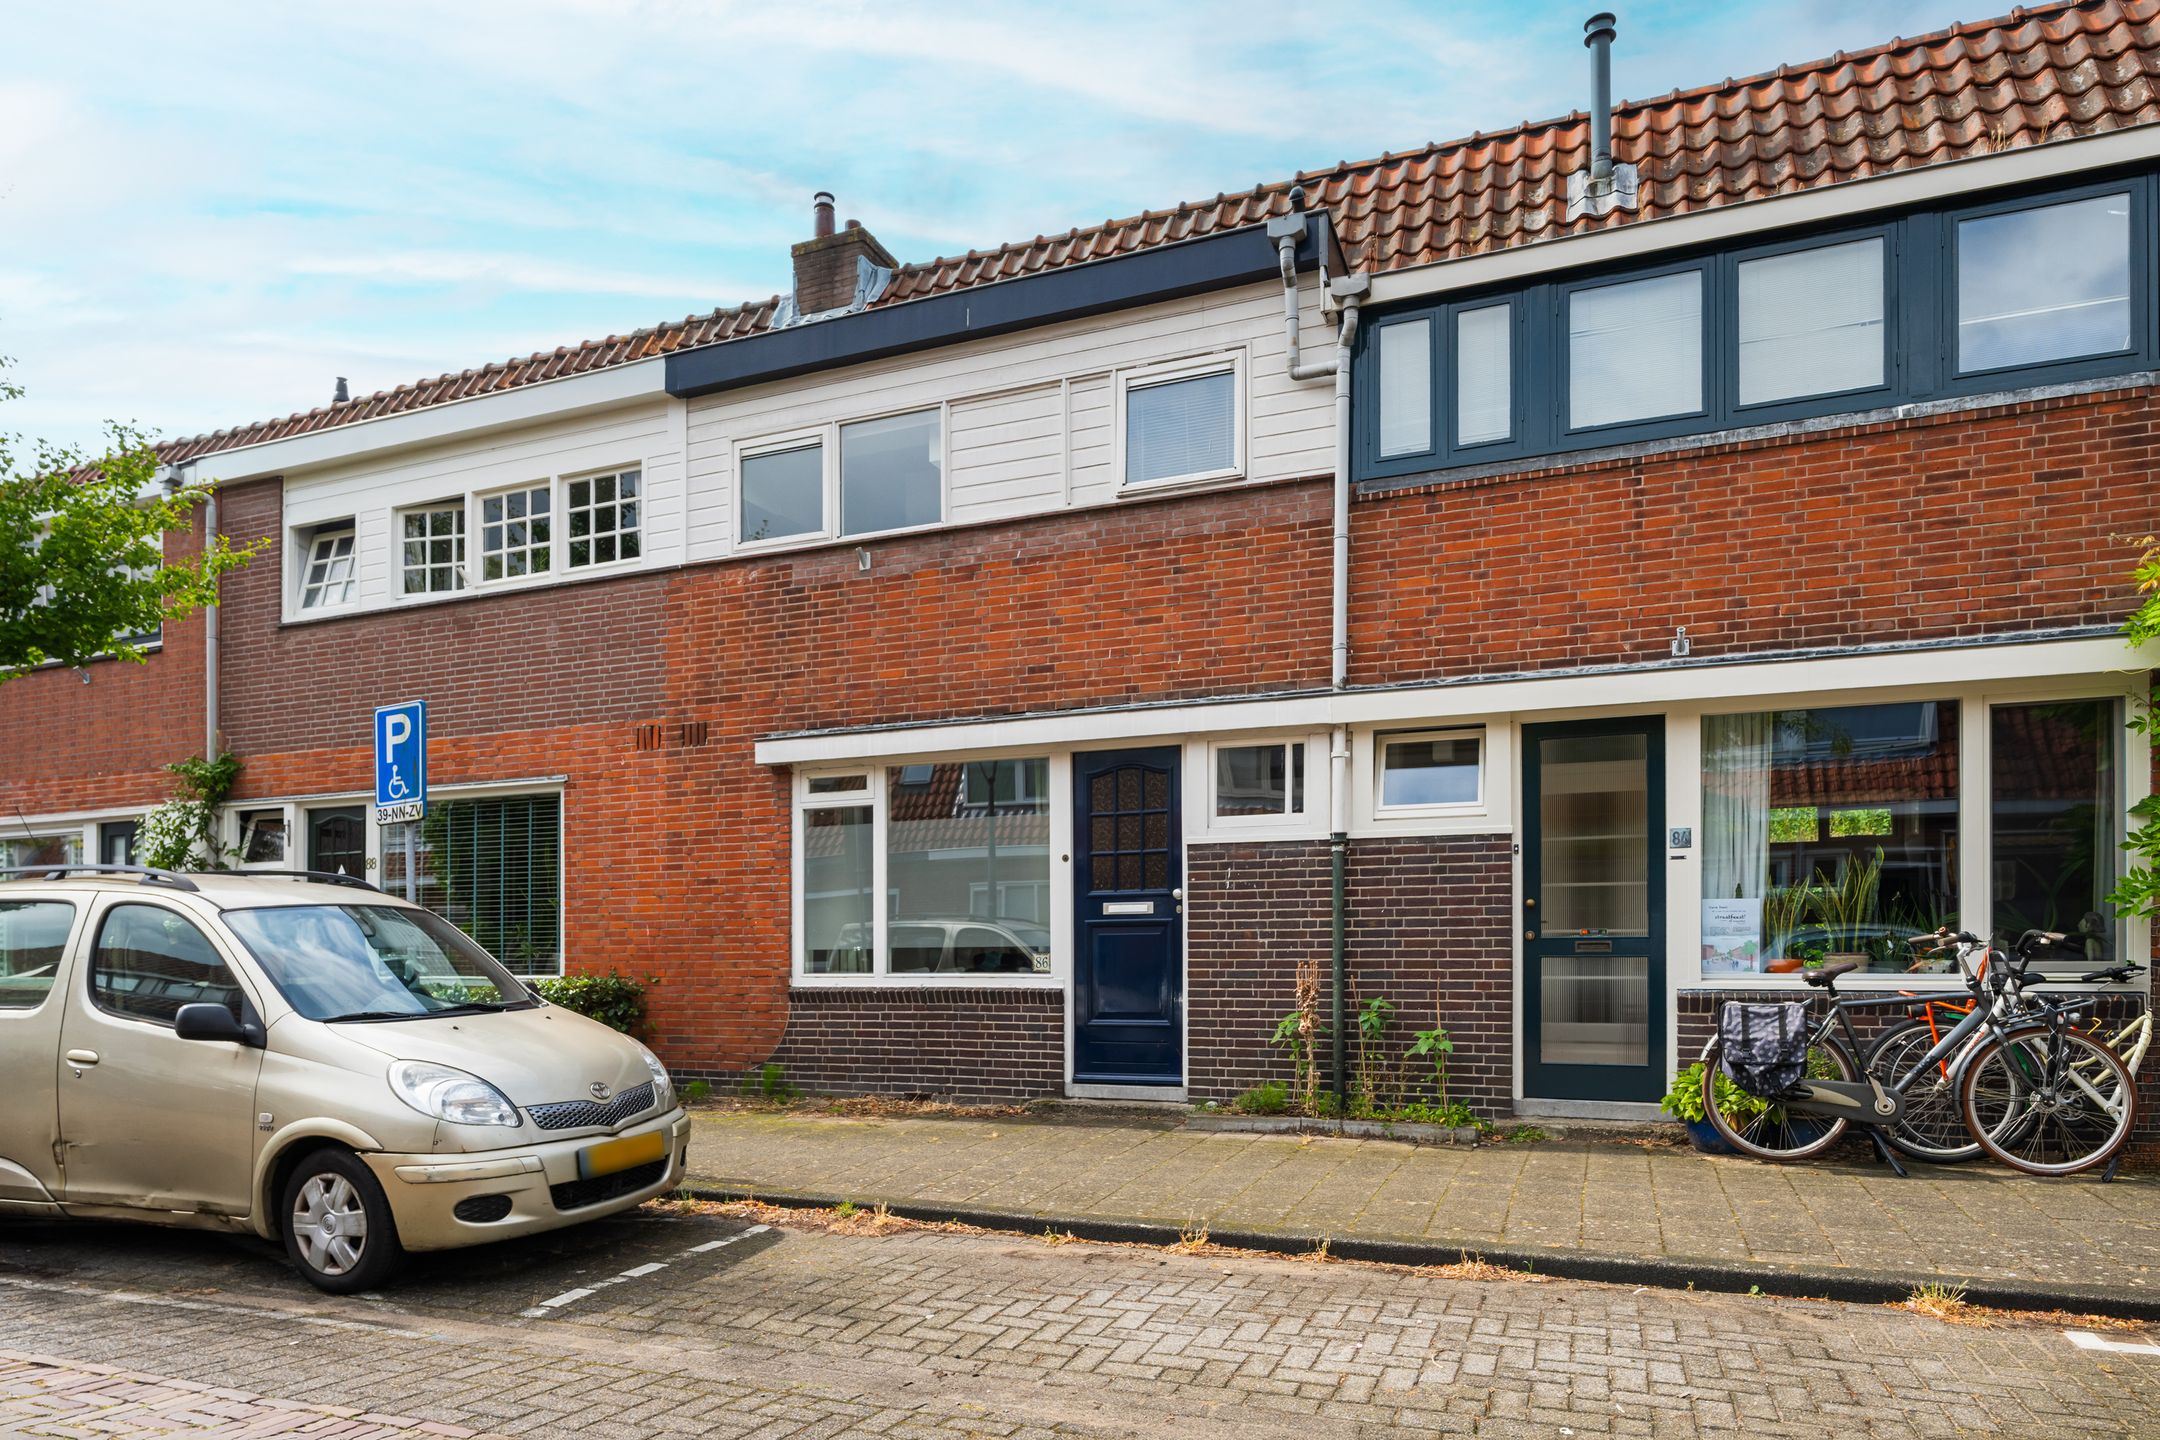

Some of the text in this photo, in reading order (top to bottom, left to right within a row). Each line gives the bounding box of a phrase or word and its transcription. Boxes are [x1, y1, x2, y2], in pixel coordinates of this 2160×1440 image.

[385, 713, 412, 764] P
[377, 804, 422, 822] 39-NN-ZV
[1672, 831, 1689, 846] 84
[366, 857, 377, 870] 88
[1035, 956, 1049, 969] 86
